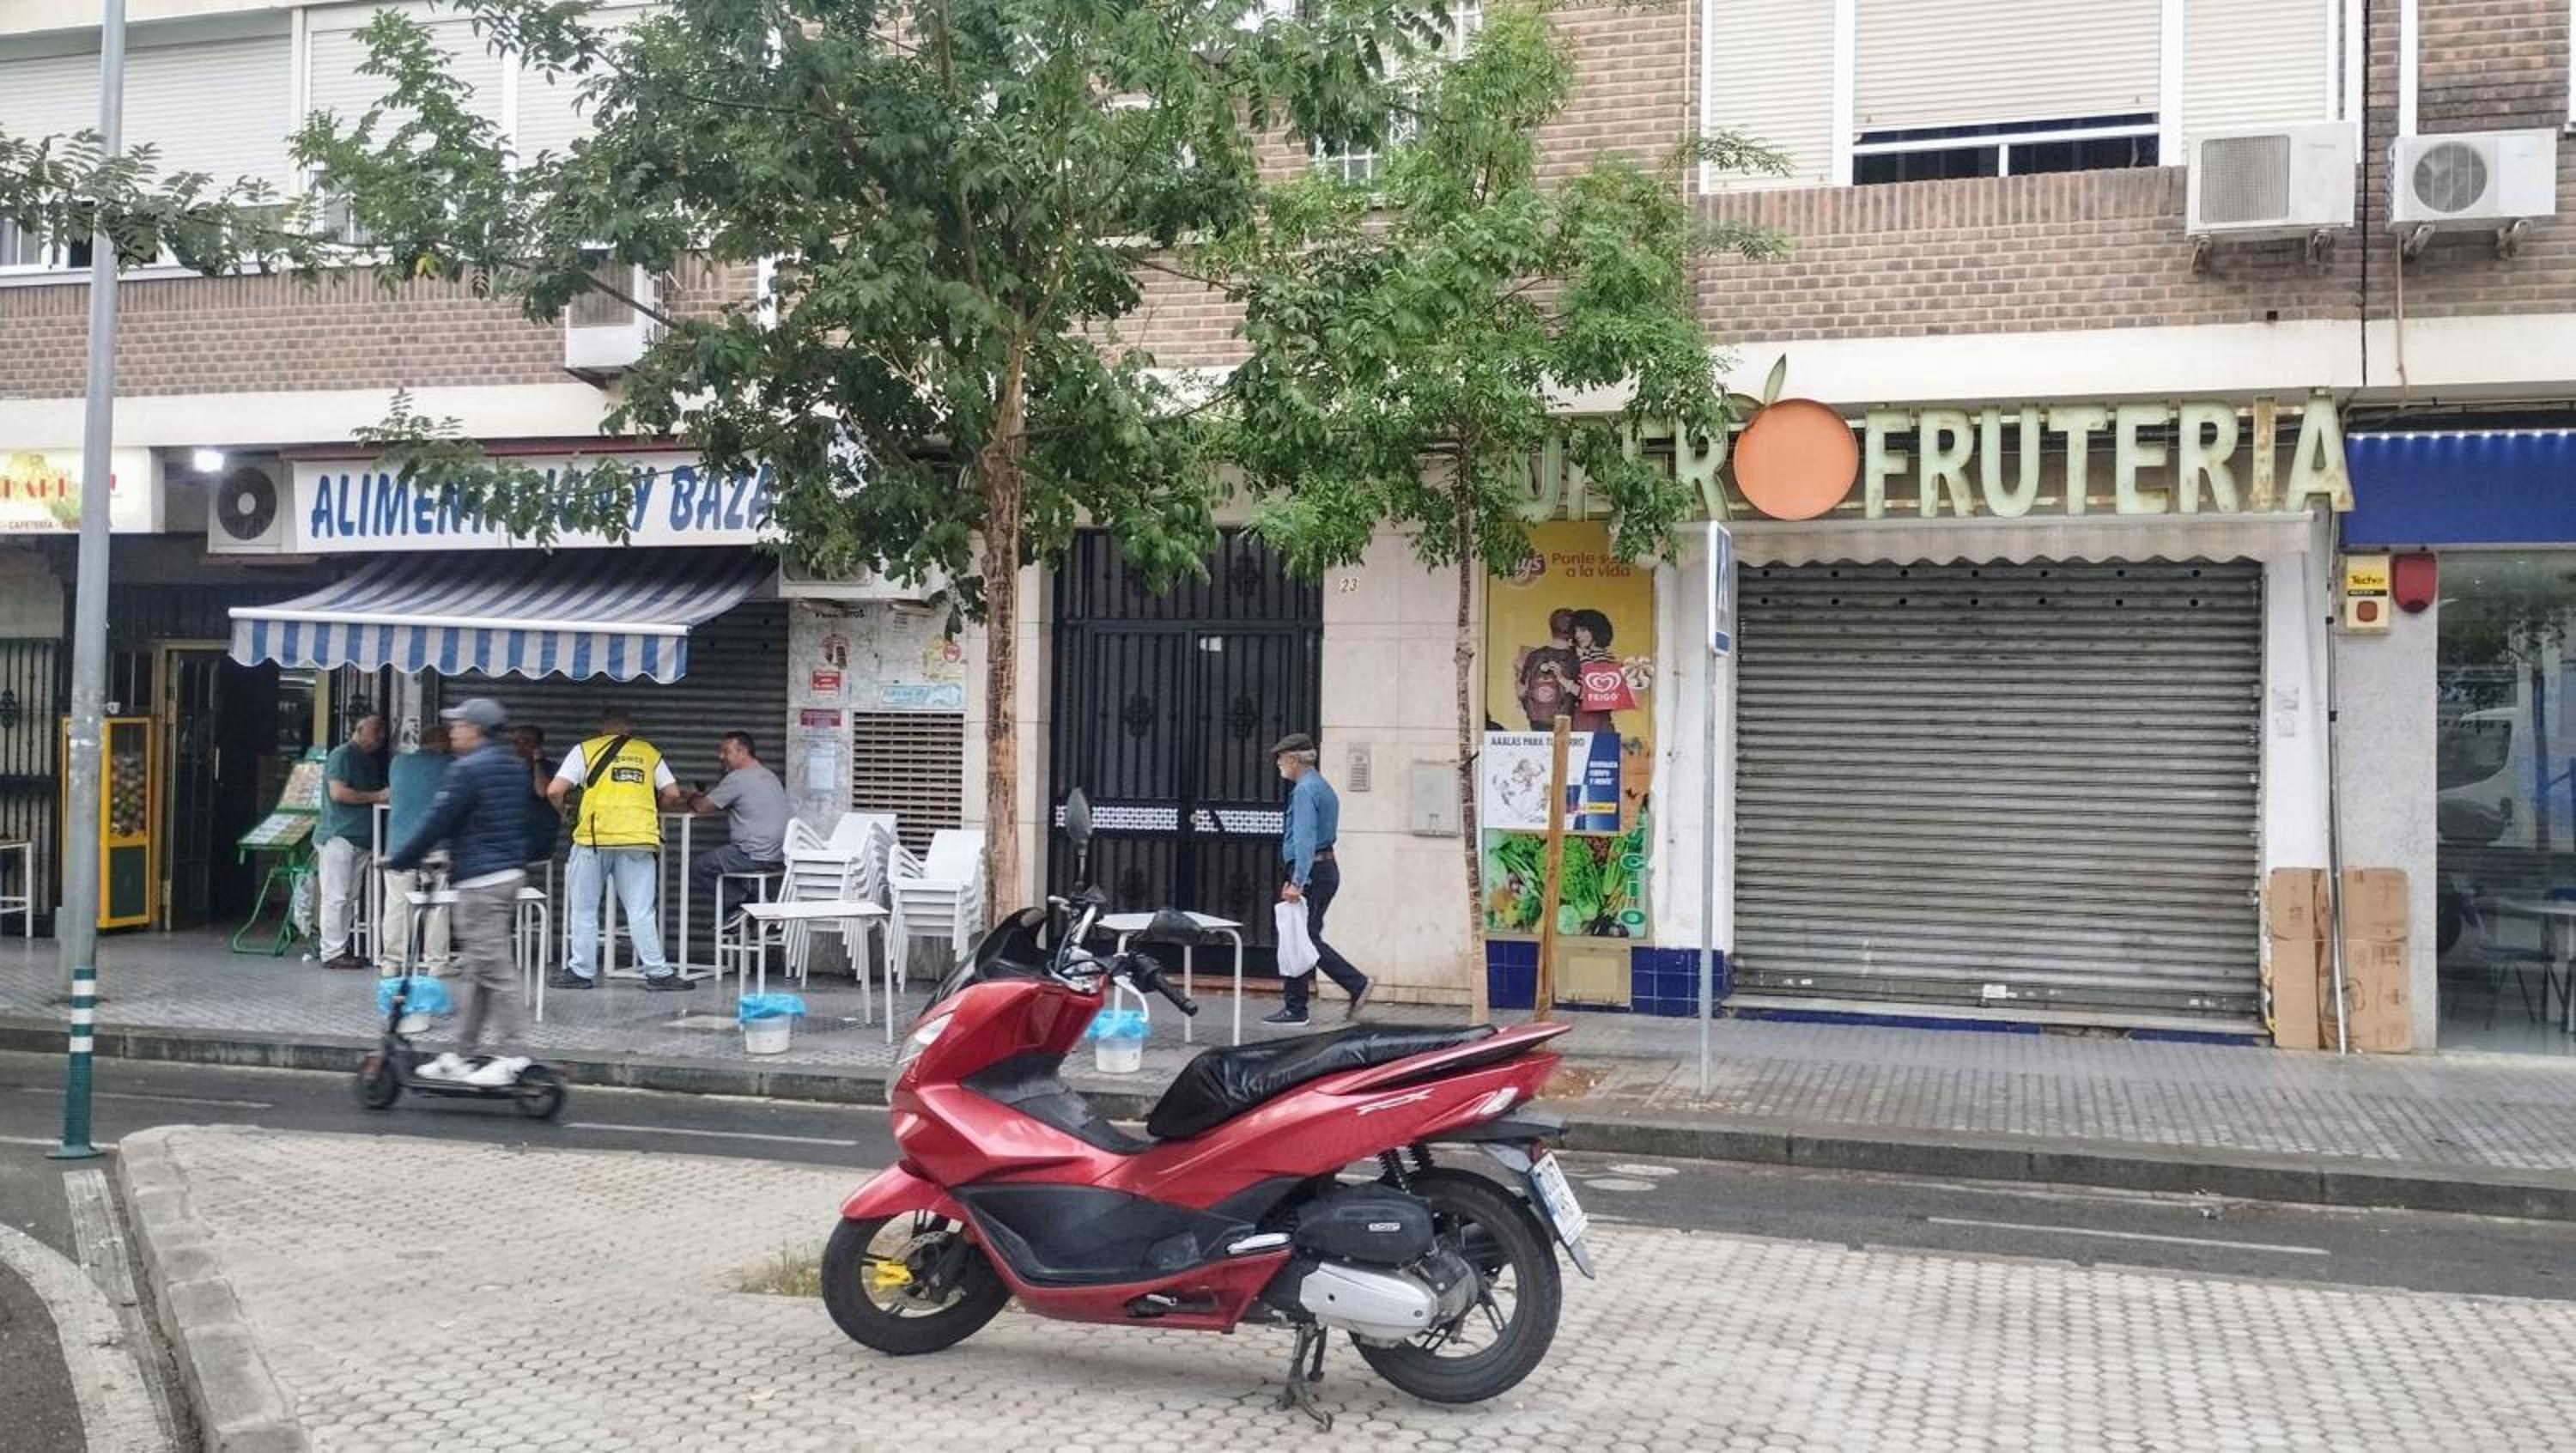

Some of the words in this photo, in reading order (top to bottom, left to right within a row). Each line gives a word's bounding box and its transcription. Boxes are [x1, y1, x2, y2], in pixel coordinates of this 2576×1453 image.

[1864, 388, 2355, 520] FRUTERIA
[630, 466, 657, 532] Y
[670, 464, 773, 532] BAZA
[1552, 552, 1595, 565] Ponle
[1579, 565, 1594, 578] la
[1597, 565, 1631, 578] vida
[1341, 578, 1358, 593] 23
